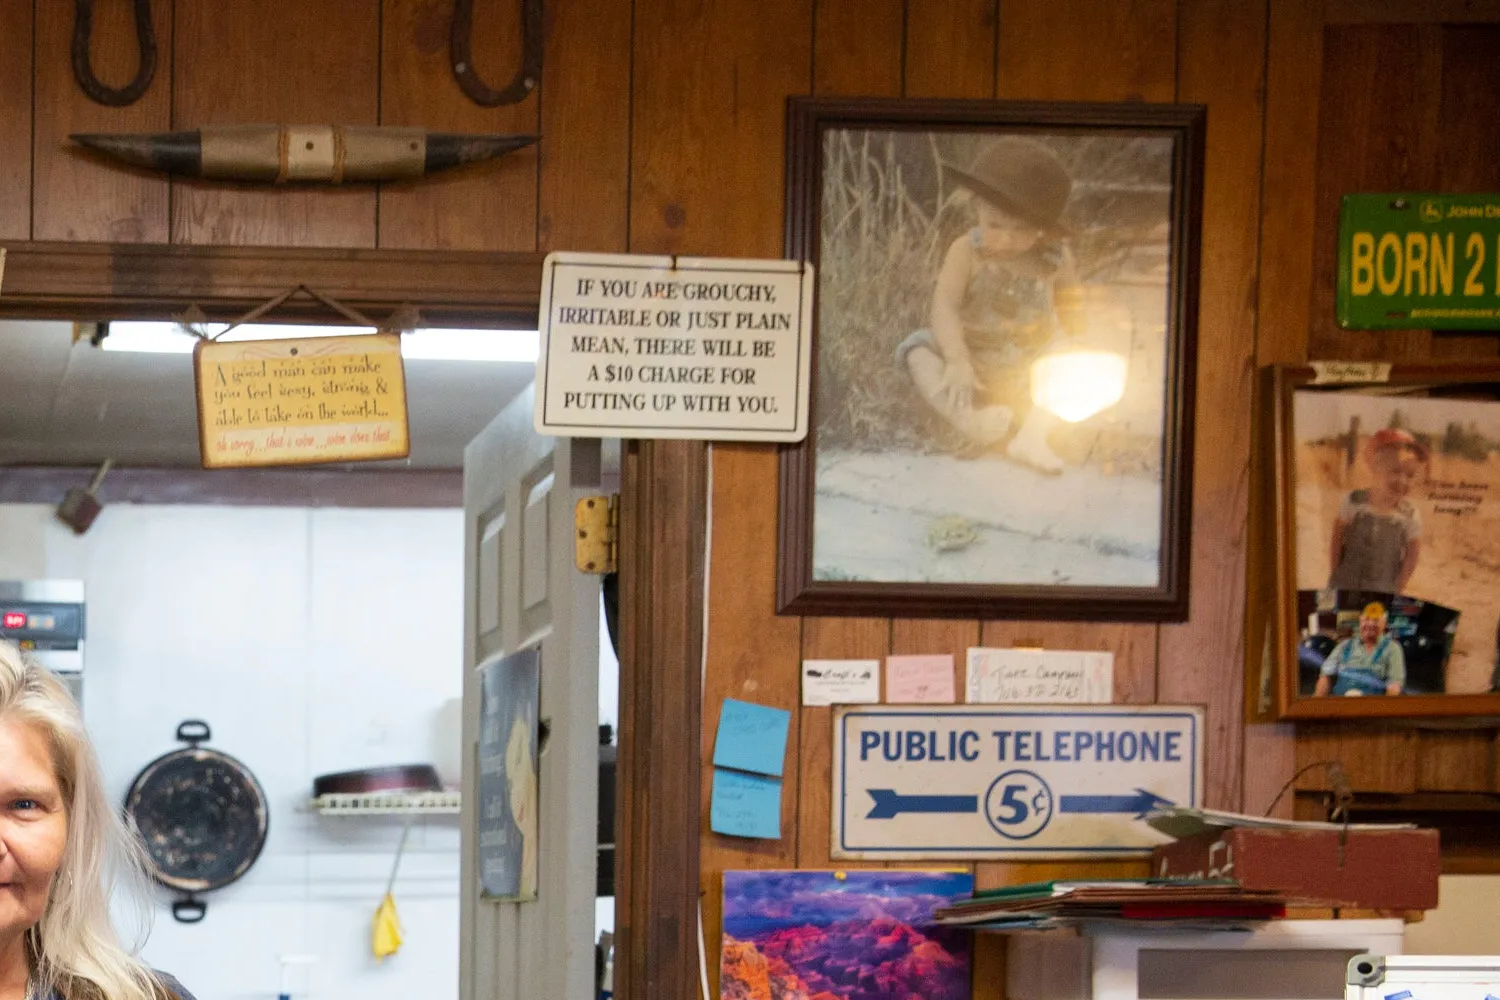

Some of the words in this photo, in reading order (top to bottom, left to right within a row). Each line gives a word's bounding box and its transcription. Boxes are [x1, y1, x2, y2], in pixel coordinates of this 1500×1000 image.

[1352, 231, 1454, 296] BORN
[1464, 232, 1485, 296] 2
[577, 279, 594, 296] IF
[601, 280, 637, 297] YOU
[642, 282, 678, 299] ARE
[684, 283, 776, 303] GROUCHY,
[559, 307, 651, 326] IRRITABLE
[657, 311, 680, 327] OR
[687, 312, 731, 330] JUST
[736, 313, 791, 330] PLAIN
[571, 337, 628, 356] MEAN,
[635, 338, 695, 356] THERE
[703, 340, 746, 357] WILL
[752, 341, 775, 358] BE
[587, 365, 598, 381] A
[605, 365, 633, 383] $10
[639, 367, 714, 384] CHARGE
[720, 368, 755, 384] FOR
[564, 392, 646, 410] PUTTING
[653, 395, 676, 411] UP
[684, 396, 730, 412] WITH
[737, 397, 778, 413] YOU.
[860, 731, 979, 762] PUBLIC
[992, 731, 1181, 762] TELEPHONE
